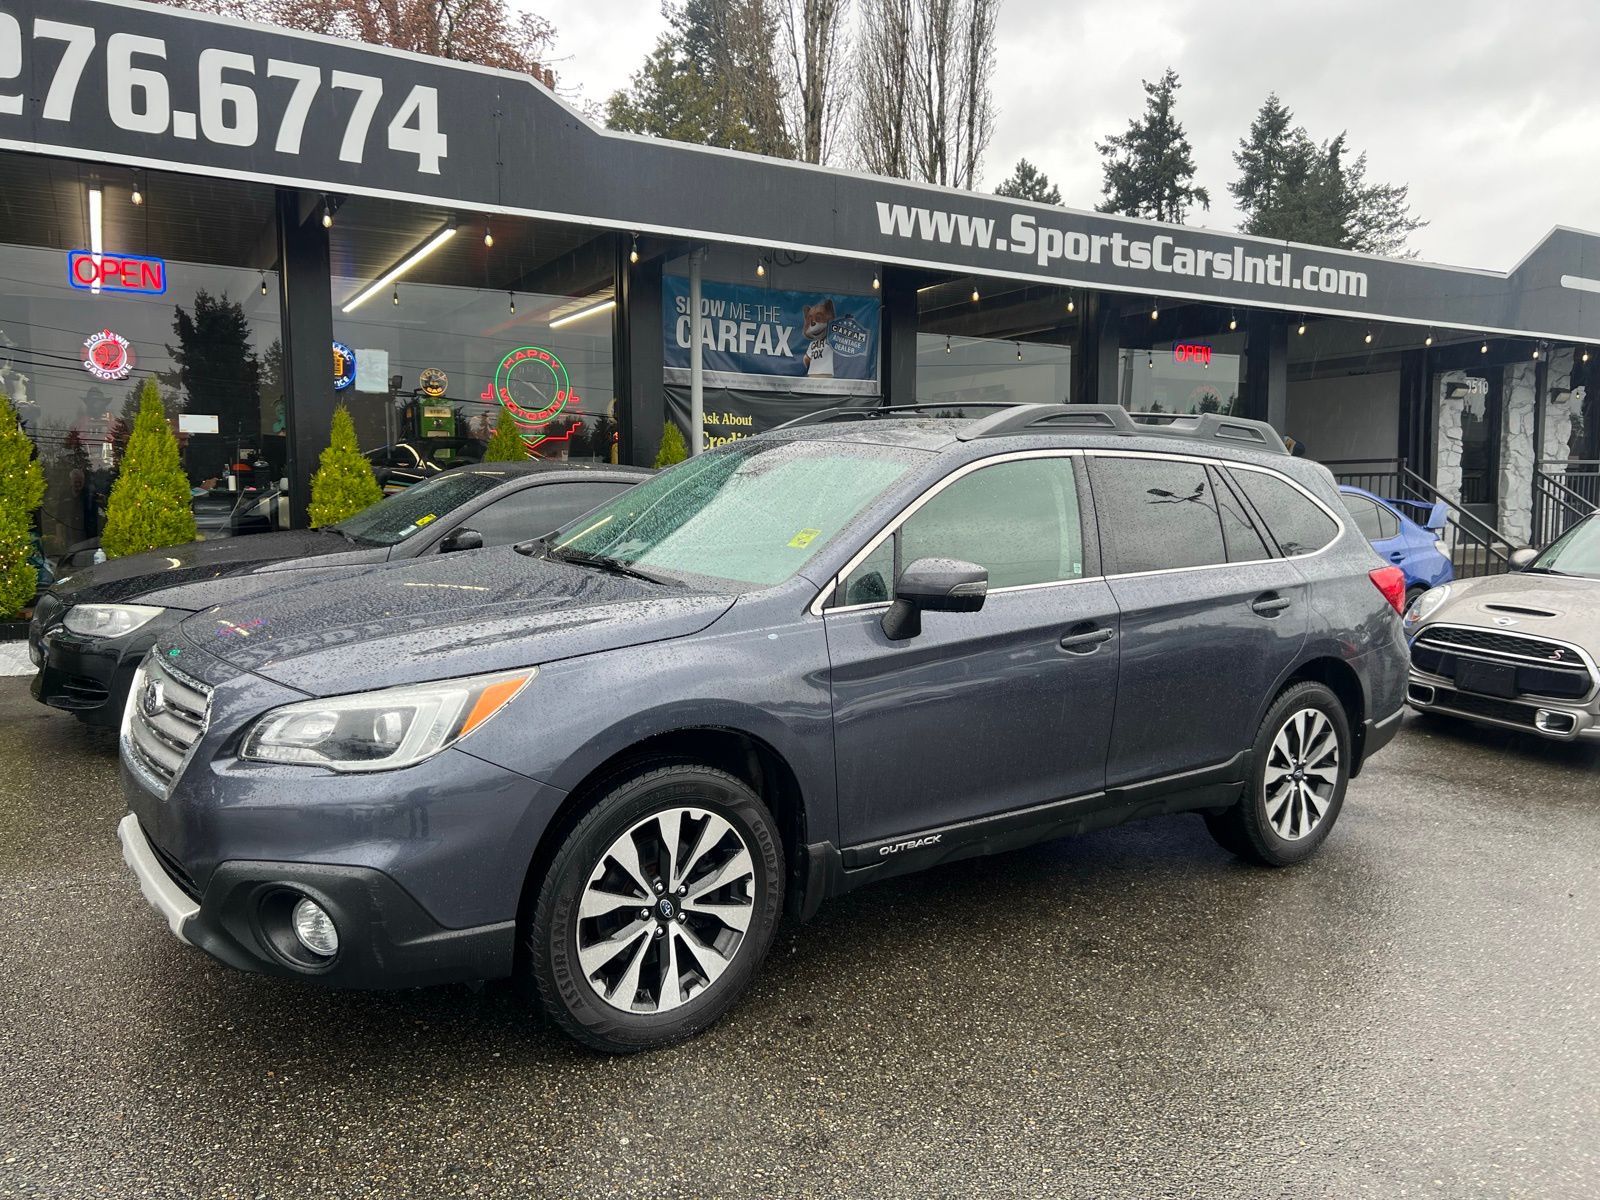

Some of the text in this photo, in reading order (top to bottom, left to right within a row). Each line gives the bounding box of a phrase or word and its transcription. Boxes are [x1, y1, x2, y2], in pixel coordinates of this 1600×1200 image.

[876, 201, 1368, 298] www.SportsCarsIntl.com
[72, 255, 163, 289] OPEN
[675, 295, 781, 324] SOW ME THE
[83, 331, 130, 349] MOHAWK
[676, 315, 794, 357] CARFAX
[831, 325, 866, 342] CARFAX
[503, 349, 560, 369] HAPPY
[1174, 344, 1212, 364] OPEN
[84, 360, 133, 379] GASOLINE
[500, 387, 566, 420] MOTORING
[702, 412, 753, 426] Ask About
[1548, 649, 1565, 661] S
[879, 834, 943, 856] OUTBACK
